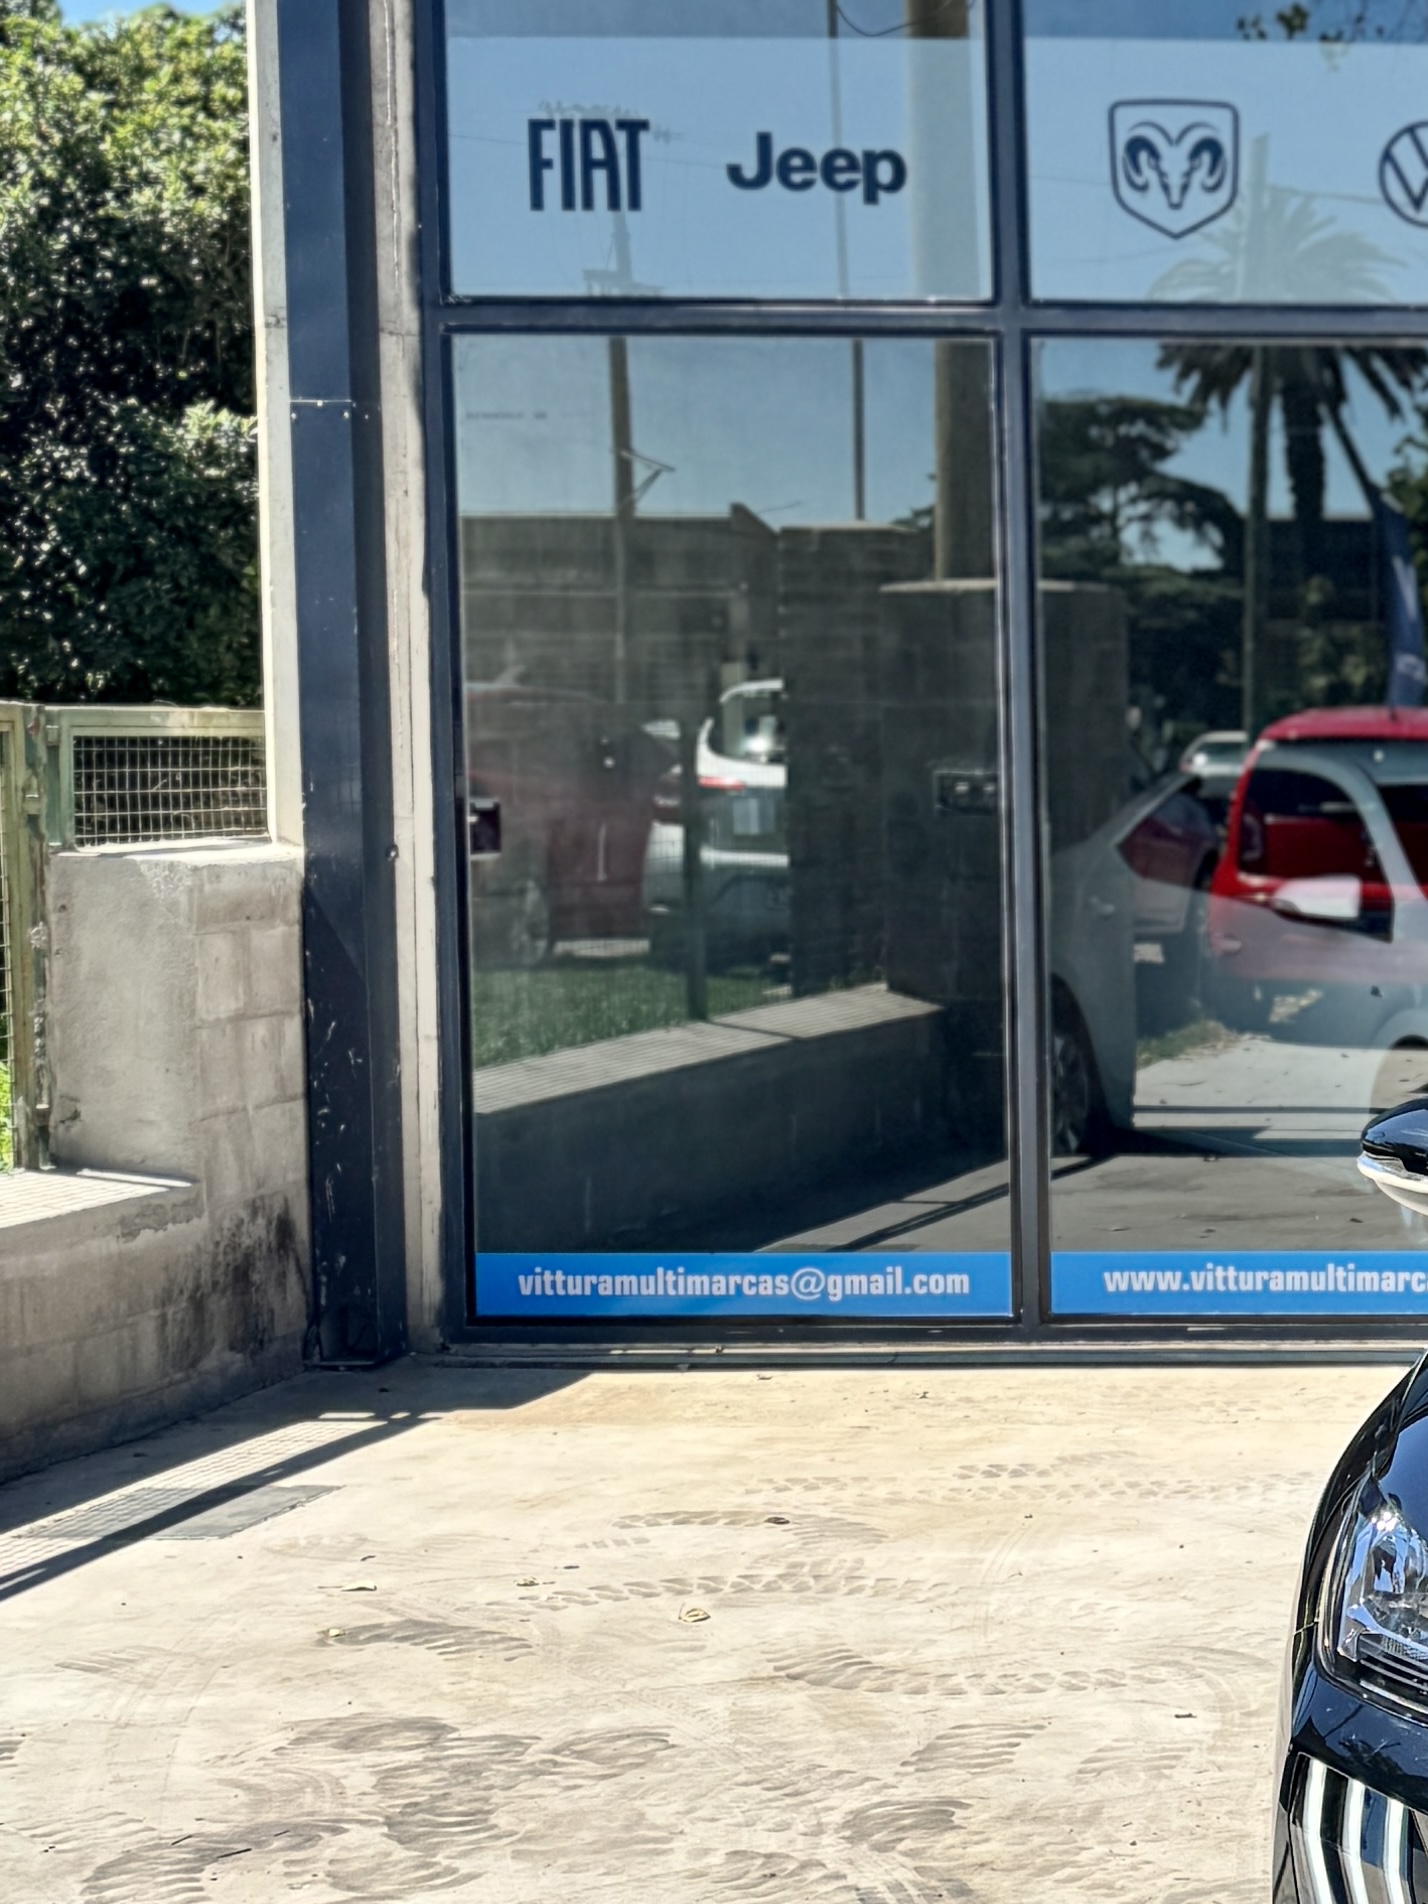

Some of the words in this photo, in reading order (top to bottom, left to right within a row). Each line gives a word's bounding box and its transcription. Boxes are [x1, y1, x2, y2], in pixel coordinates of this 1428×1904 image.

[528, 118, 650, 212] FIAT
[726, 132, 908, 205] Jeep
[518, 1266, 970, 1302] vitturamultimarcas@gmail.com
